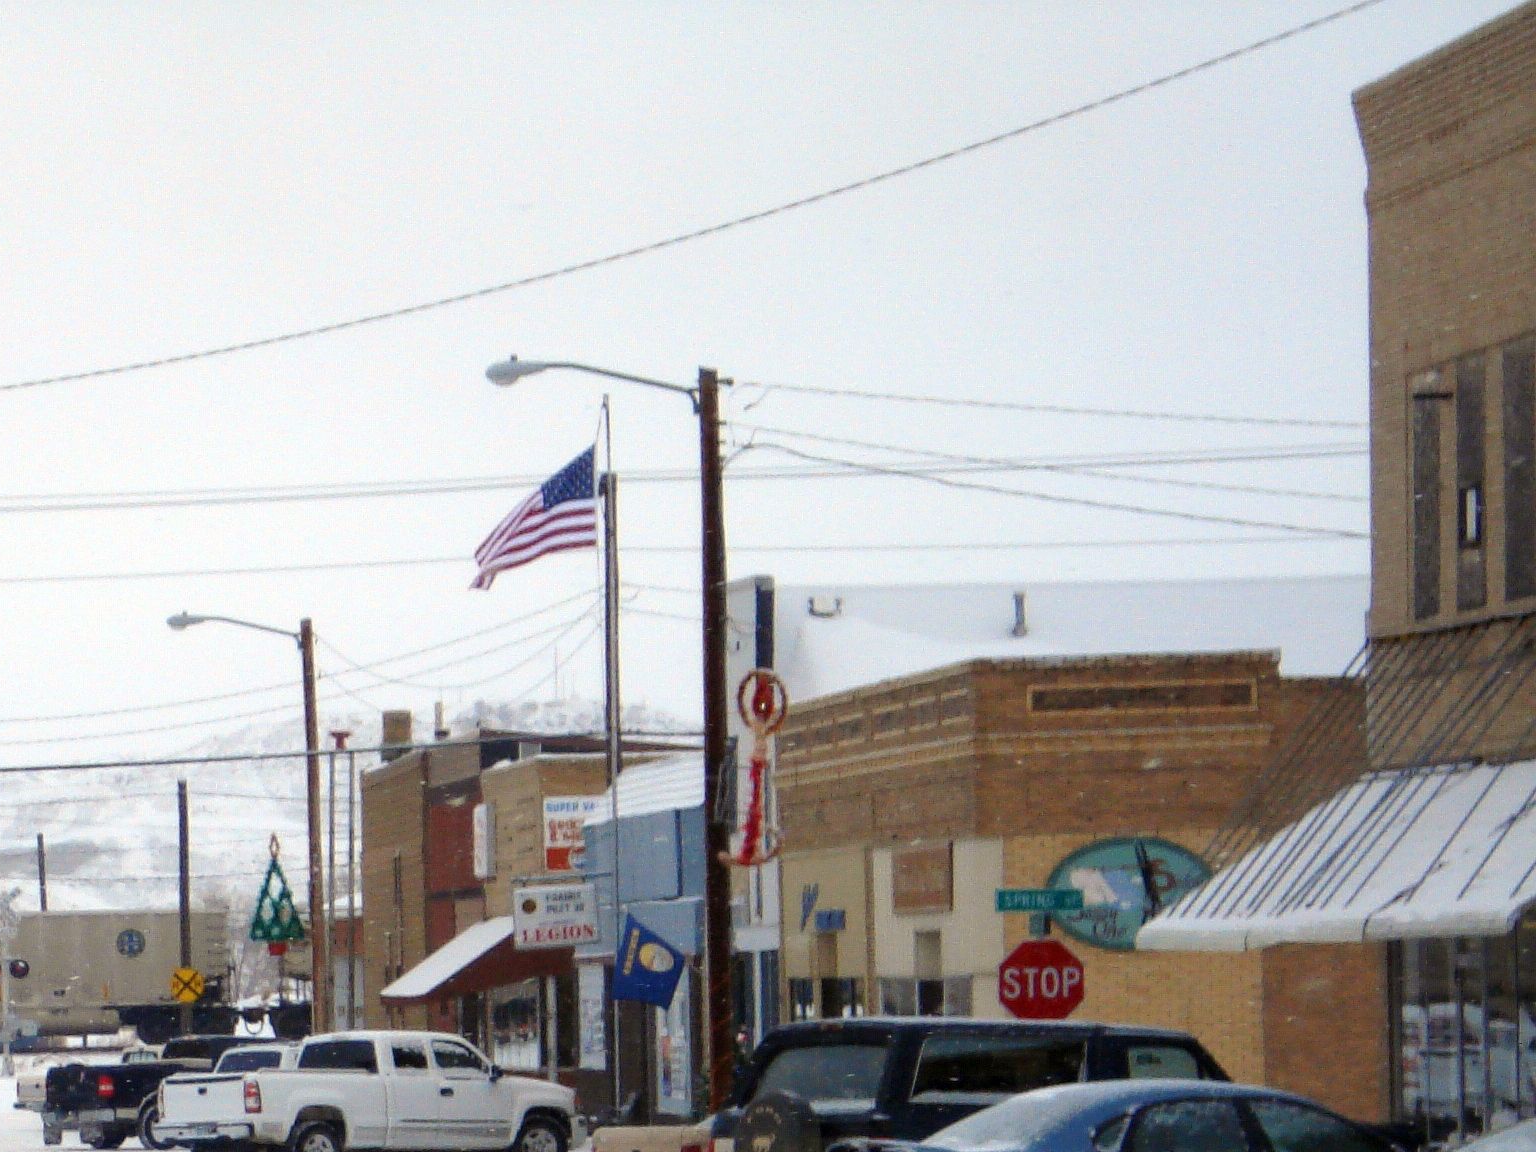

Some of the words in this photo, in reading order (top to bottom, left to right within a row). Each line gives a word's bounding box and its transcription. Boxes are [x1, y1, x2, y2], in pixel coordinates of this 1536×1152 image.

[546, 802, 579, 812] SUPER
[1004, 891, 1055, 908] SPRING
[522, 923, 594, 944] LEGION
[1003, 966, 1082, 999] STOP
